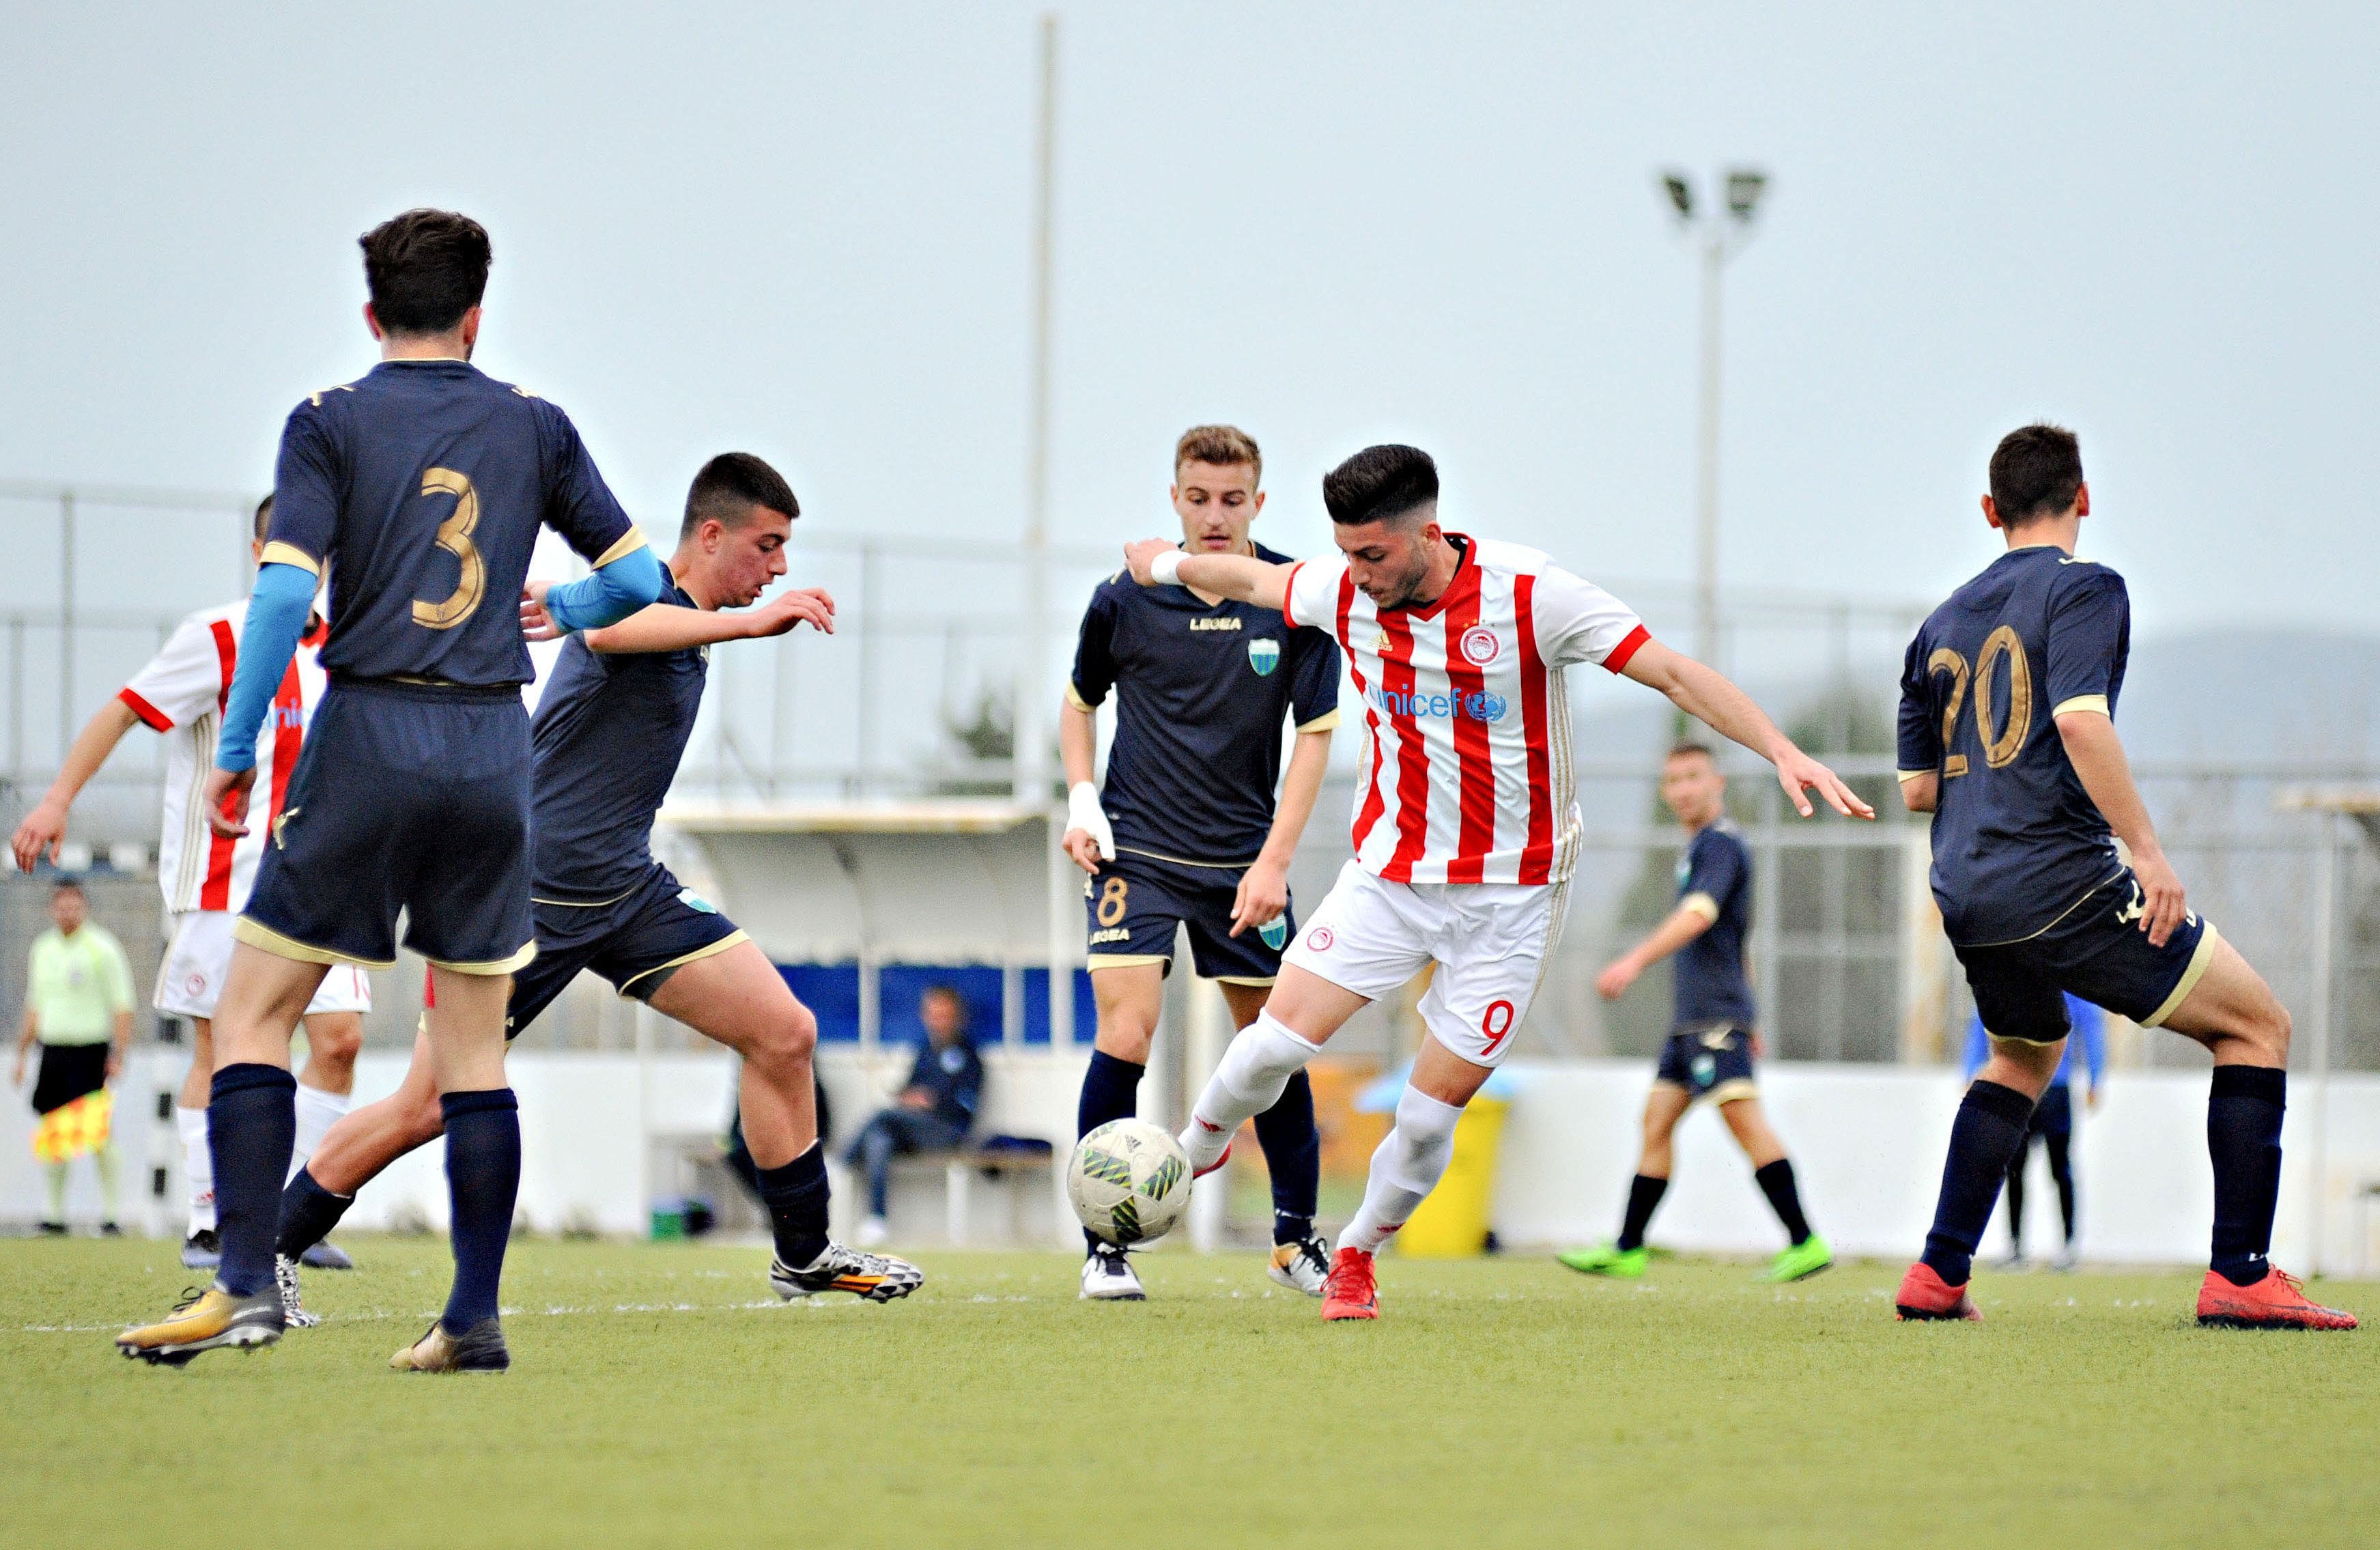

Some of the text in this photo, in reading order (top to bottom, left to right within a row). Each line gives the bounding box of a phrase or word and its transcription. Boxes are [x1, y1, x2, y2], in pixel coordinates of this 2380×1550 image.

[412, 468, 484, 630] 3
[1368, 684, 1462, 718] unicef
[1928, 625, 2032, 778] 20
[1096, 876, 1127, 927] 8
[1480, 1000, 1514, 1056] 9
